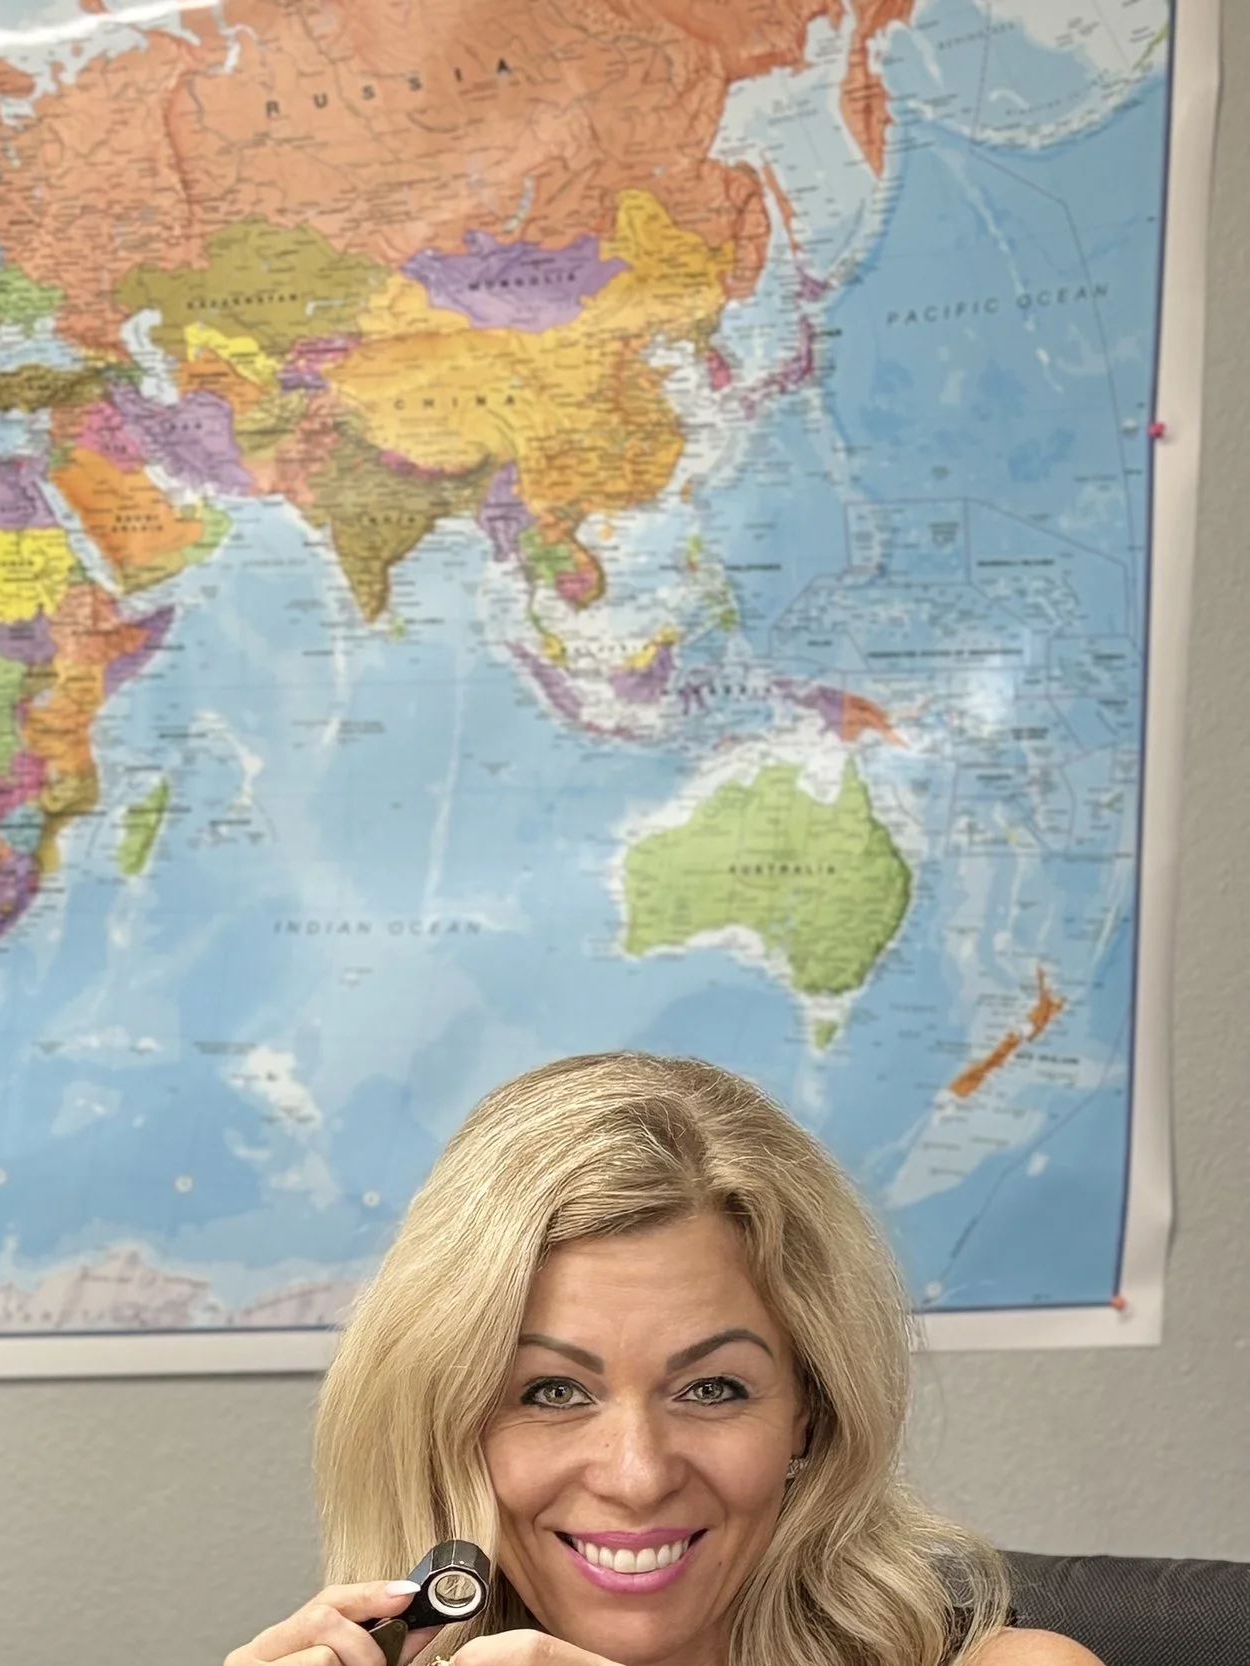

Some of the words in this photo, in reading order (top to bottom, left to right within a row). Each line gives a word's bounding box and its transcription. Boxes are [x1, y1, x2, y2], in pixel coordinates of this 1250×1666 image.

[266, 58, 512, 118] RUSSIA
[886, 296, 1000, 326] PACIFIC
[1016, 282, 1109, 311] OCEAN
[394, 394, 516, 412] CHINA
[273, 919, 373, 935] INDIAN
[388, 919, 482, 936] OCEAN
